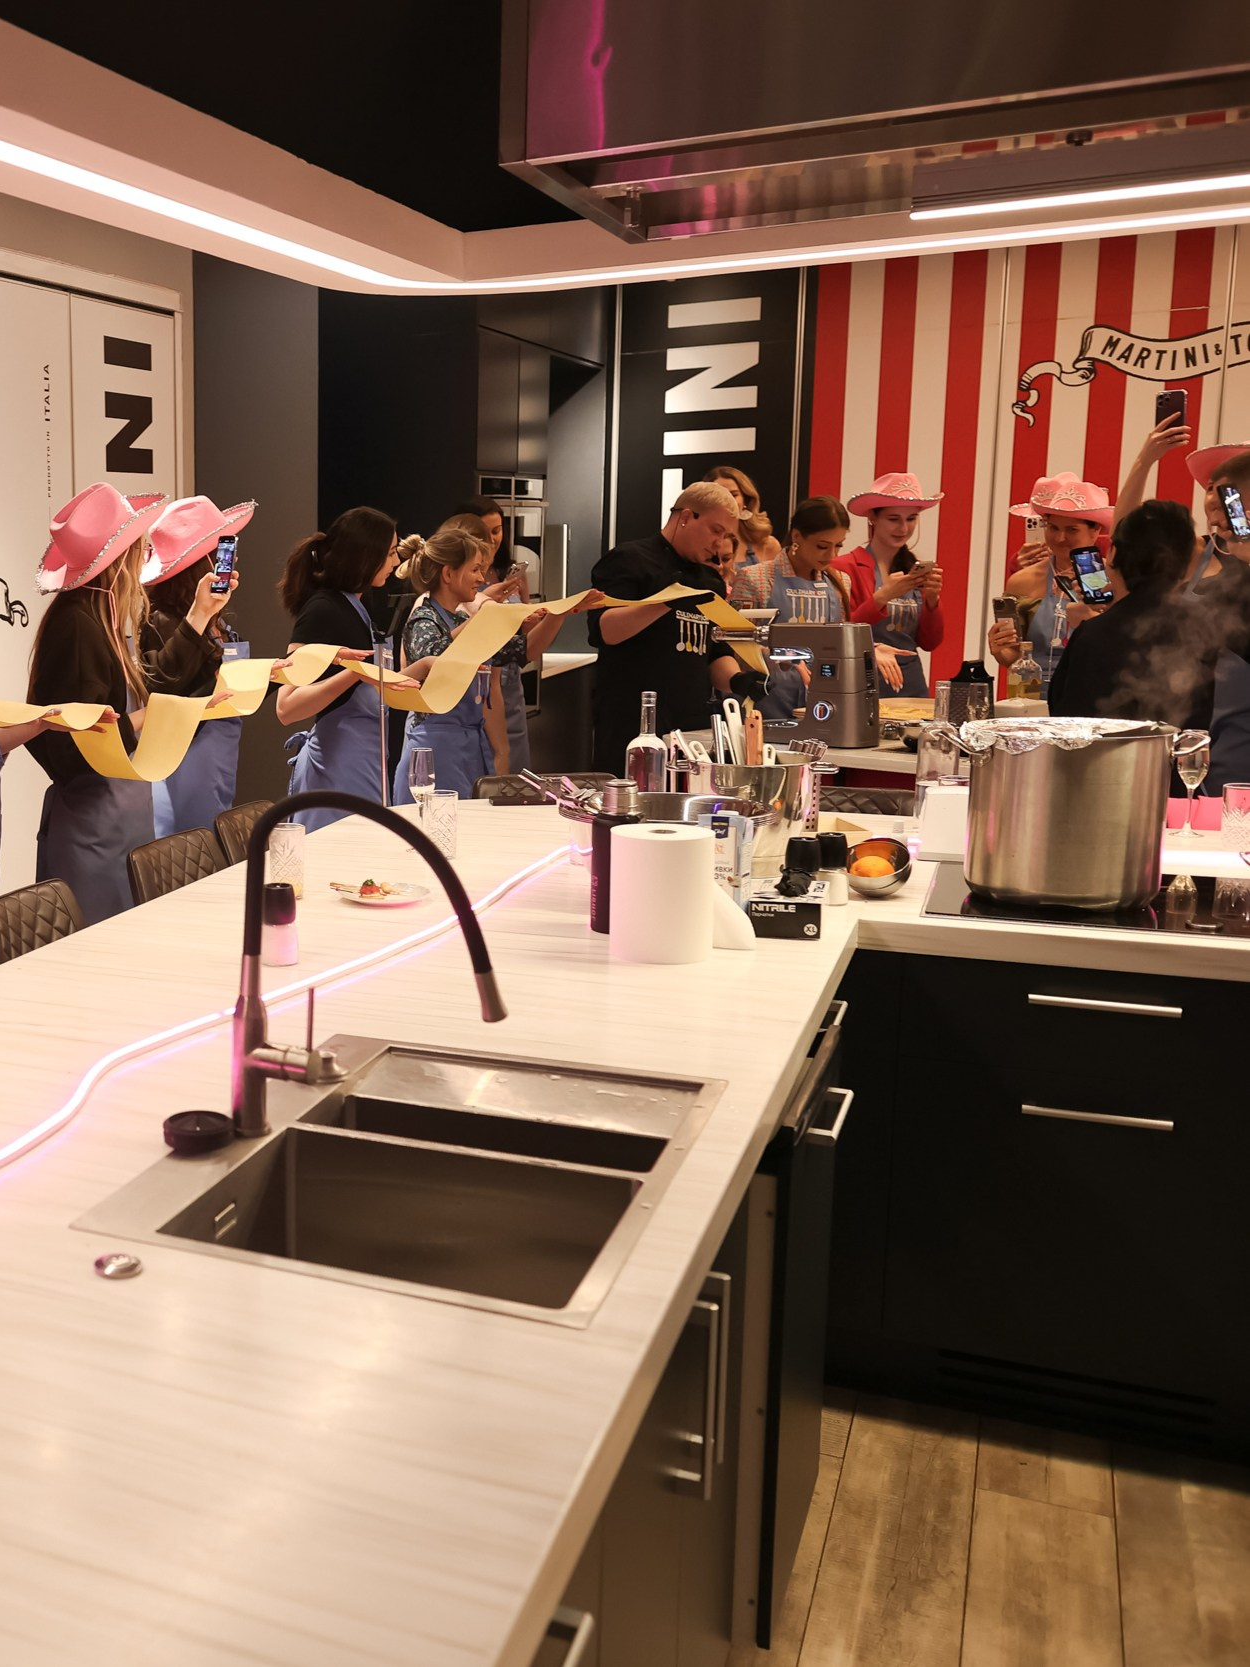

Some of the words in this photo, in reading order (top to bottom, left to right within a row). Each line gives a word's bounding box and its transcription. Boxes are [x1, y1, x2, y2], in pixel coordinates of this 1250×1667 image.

[1101, 335, 1210, 371] MARTINI
[1214, 343, 1222, 355] &
[1230, 334, 1250, 355] T
[43, 364, 51, 422] ITALIA
[103, 335, 153, 474] NI
[751, 903, 796, 913] NITRILE
